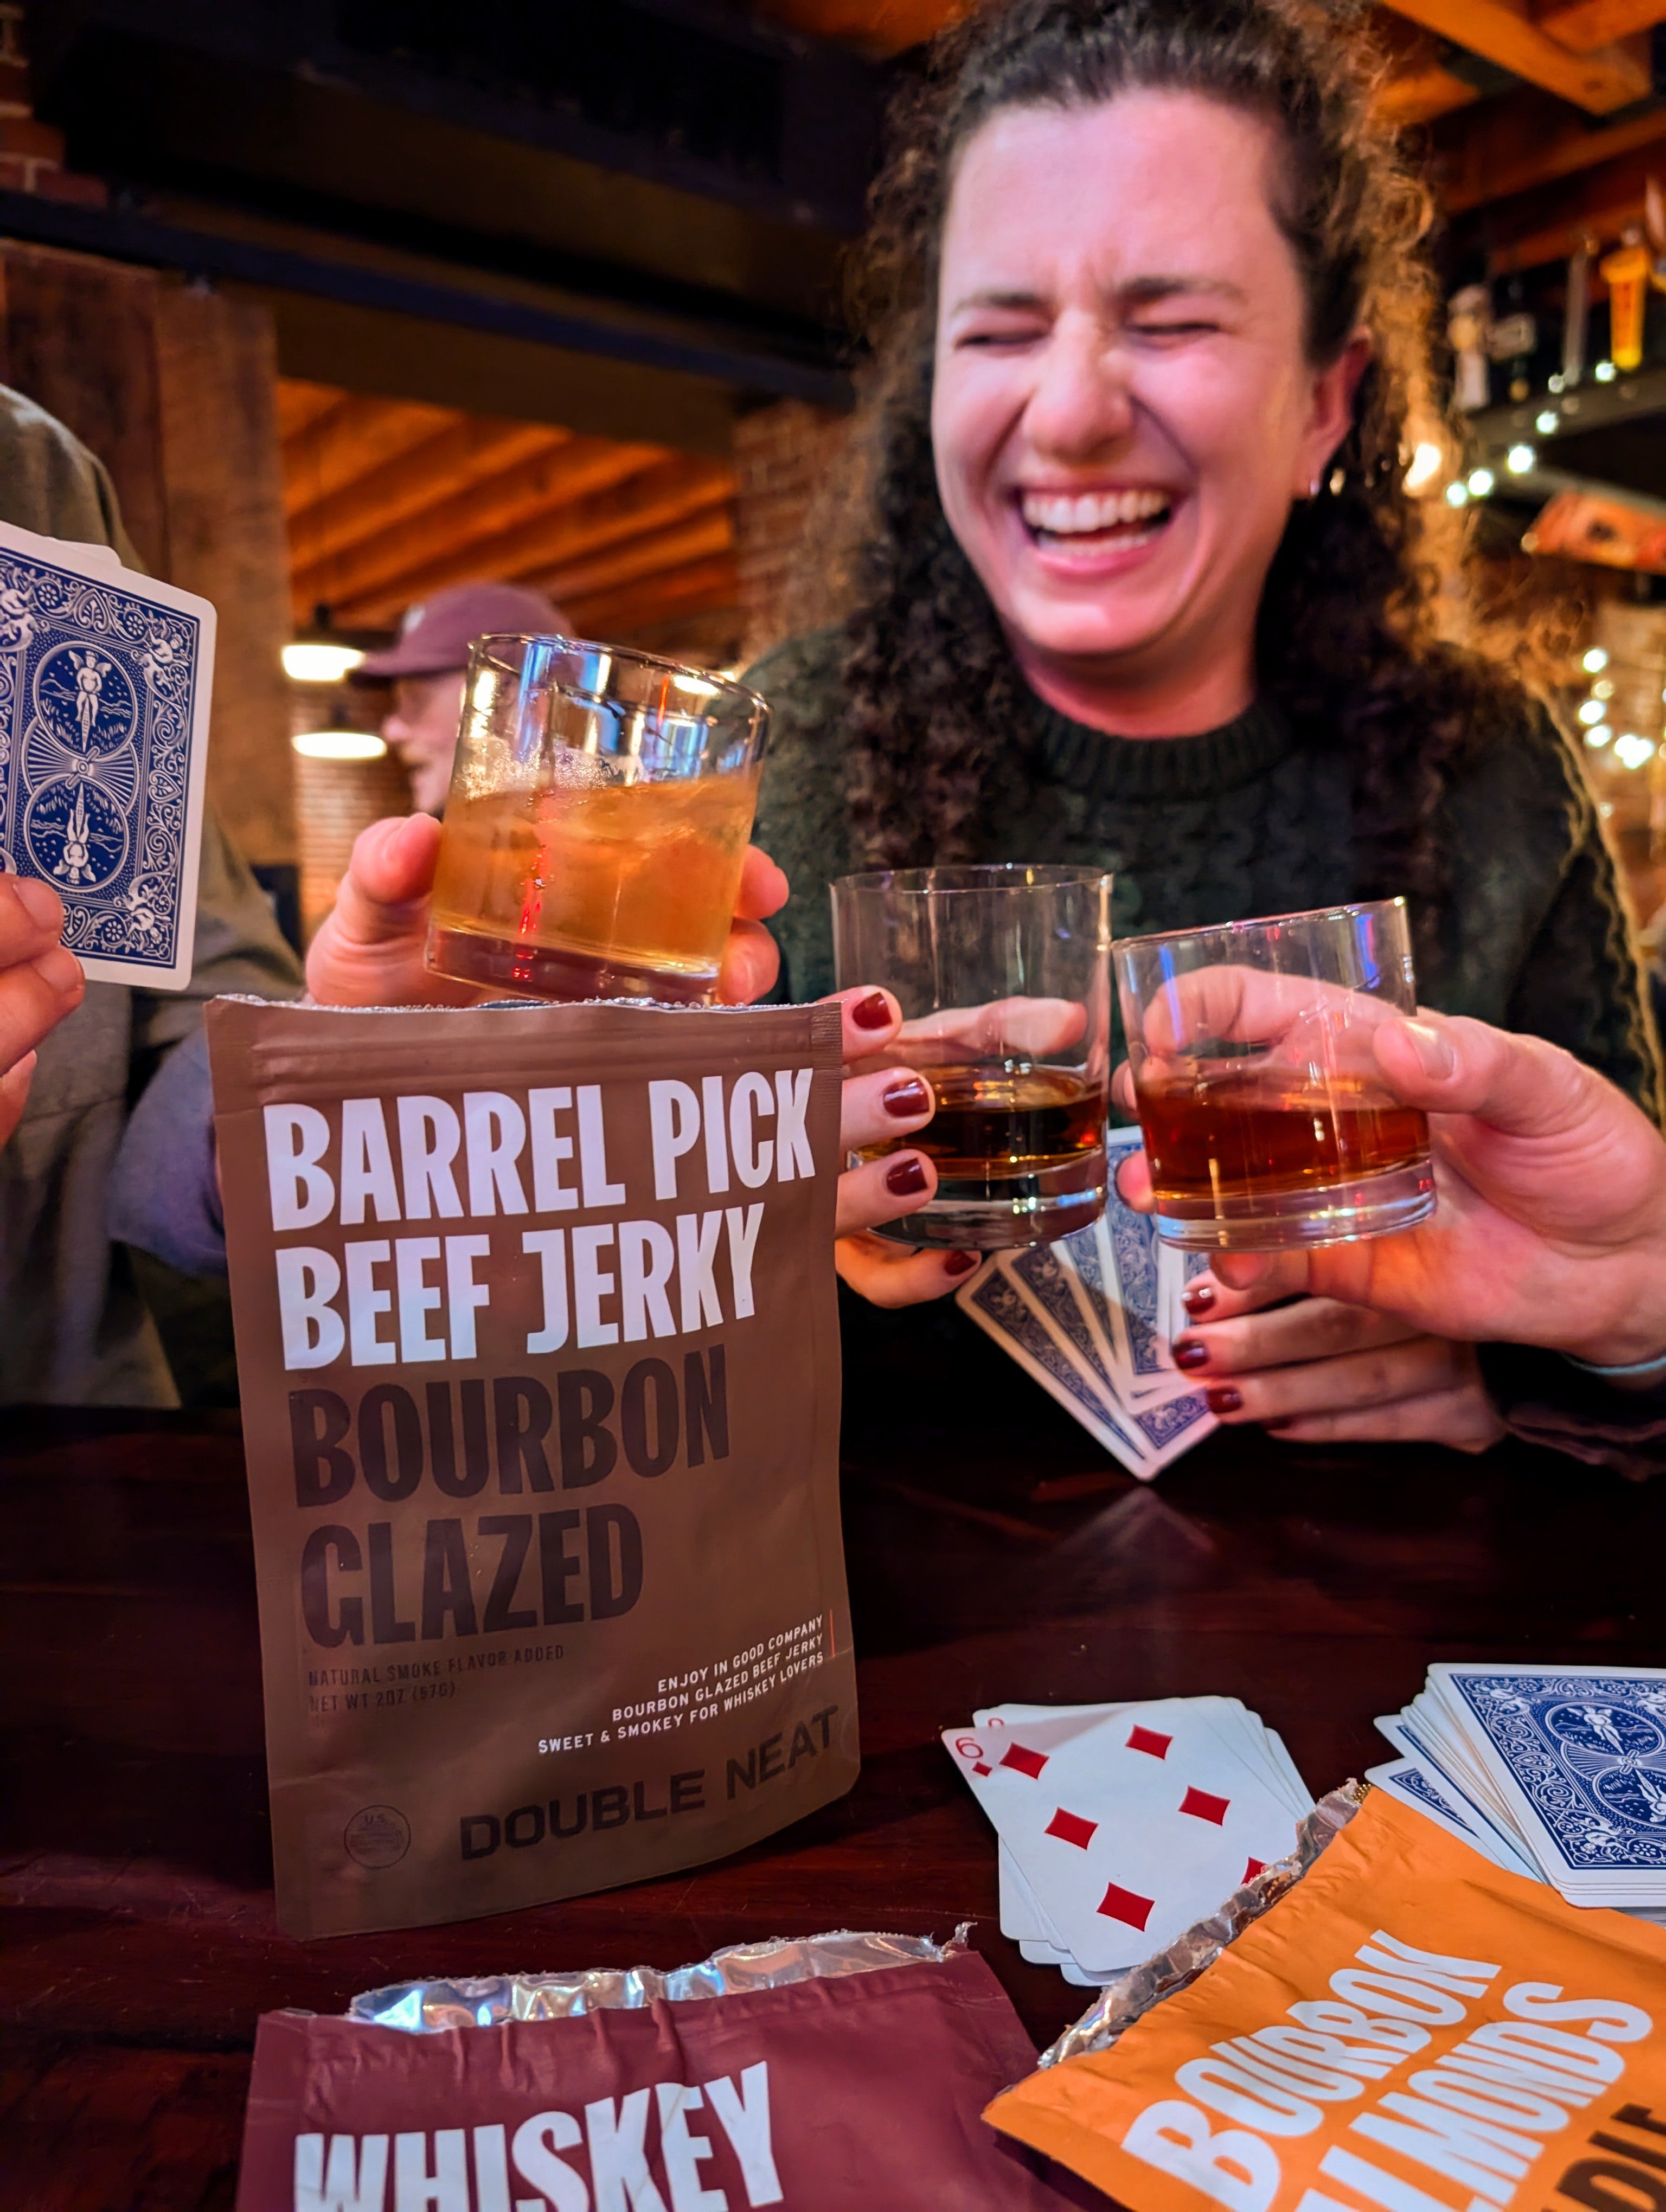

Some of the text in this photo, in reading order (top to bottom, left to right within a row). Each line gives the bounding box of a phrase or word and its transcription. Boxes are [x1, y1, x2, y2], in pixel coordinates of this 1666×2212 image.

[263, 1068, 816, 1231] BARREL PICK
[274, 1202, 765, 1371] BEEF JERKY
[290, 1346, 729, 1508] BOURBON
[302, 1503, 643, 1648] GLAZED
[309, 1644, 564, 1686] NATURAL SMOKE FLAVOR ADDED
[310, 1694, 338, 1712] NET
[345, 1692, 369, 1709] WT
[538, 1651, 824, 1755] SWEET & SMOKEY FOR WHISKEY LOVERS
[612, 1632, 823, 1722] BOURBON GLAZED BEEF JERKY
[658, 1614, 823, 1693] ENJOY IN GOOD COMPANY
[460, 1706, 839, 1861] DOUBLE NEAT
[955, 1737, 983, 1758] 6
[294, 2061, 784, 2212] WHISKEY
[1295, 1982, 1653, 2212] LMONDS
